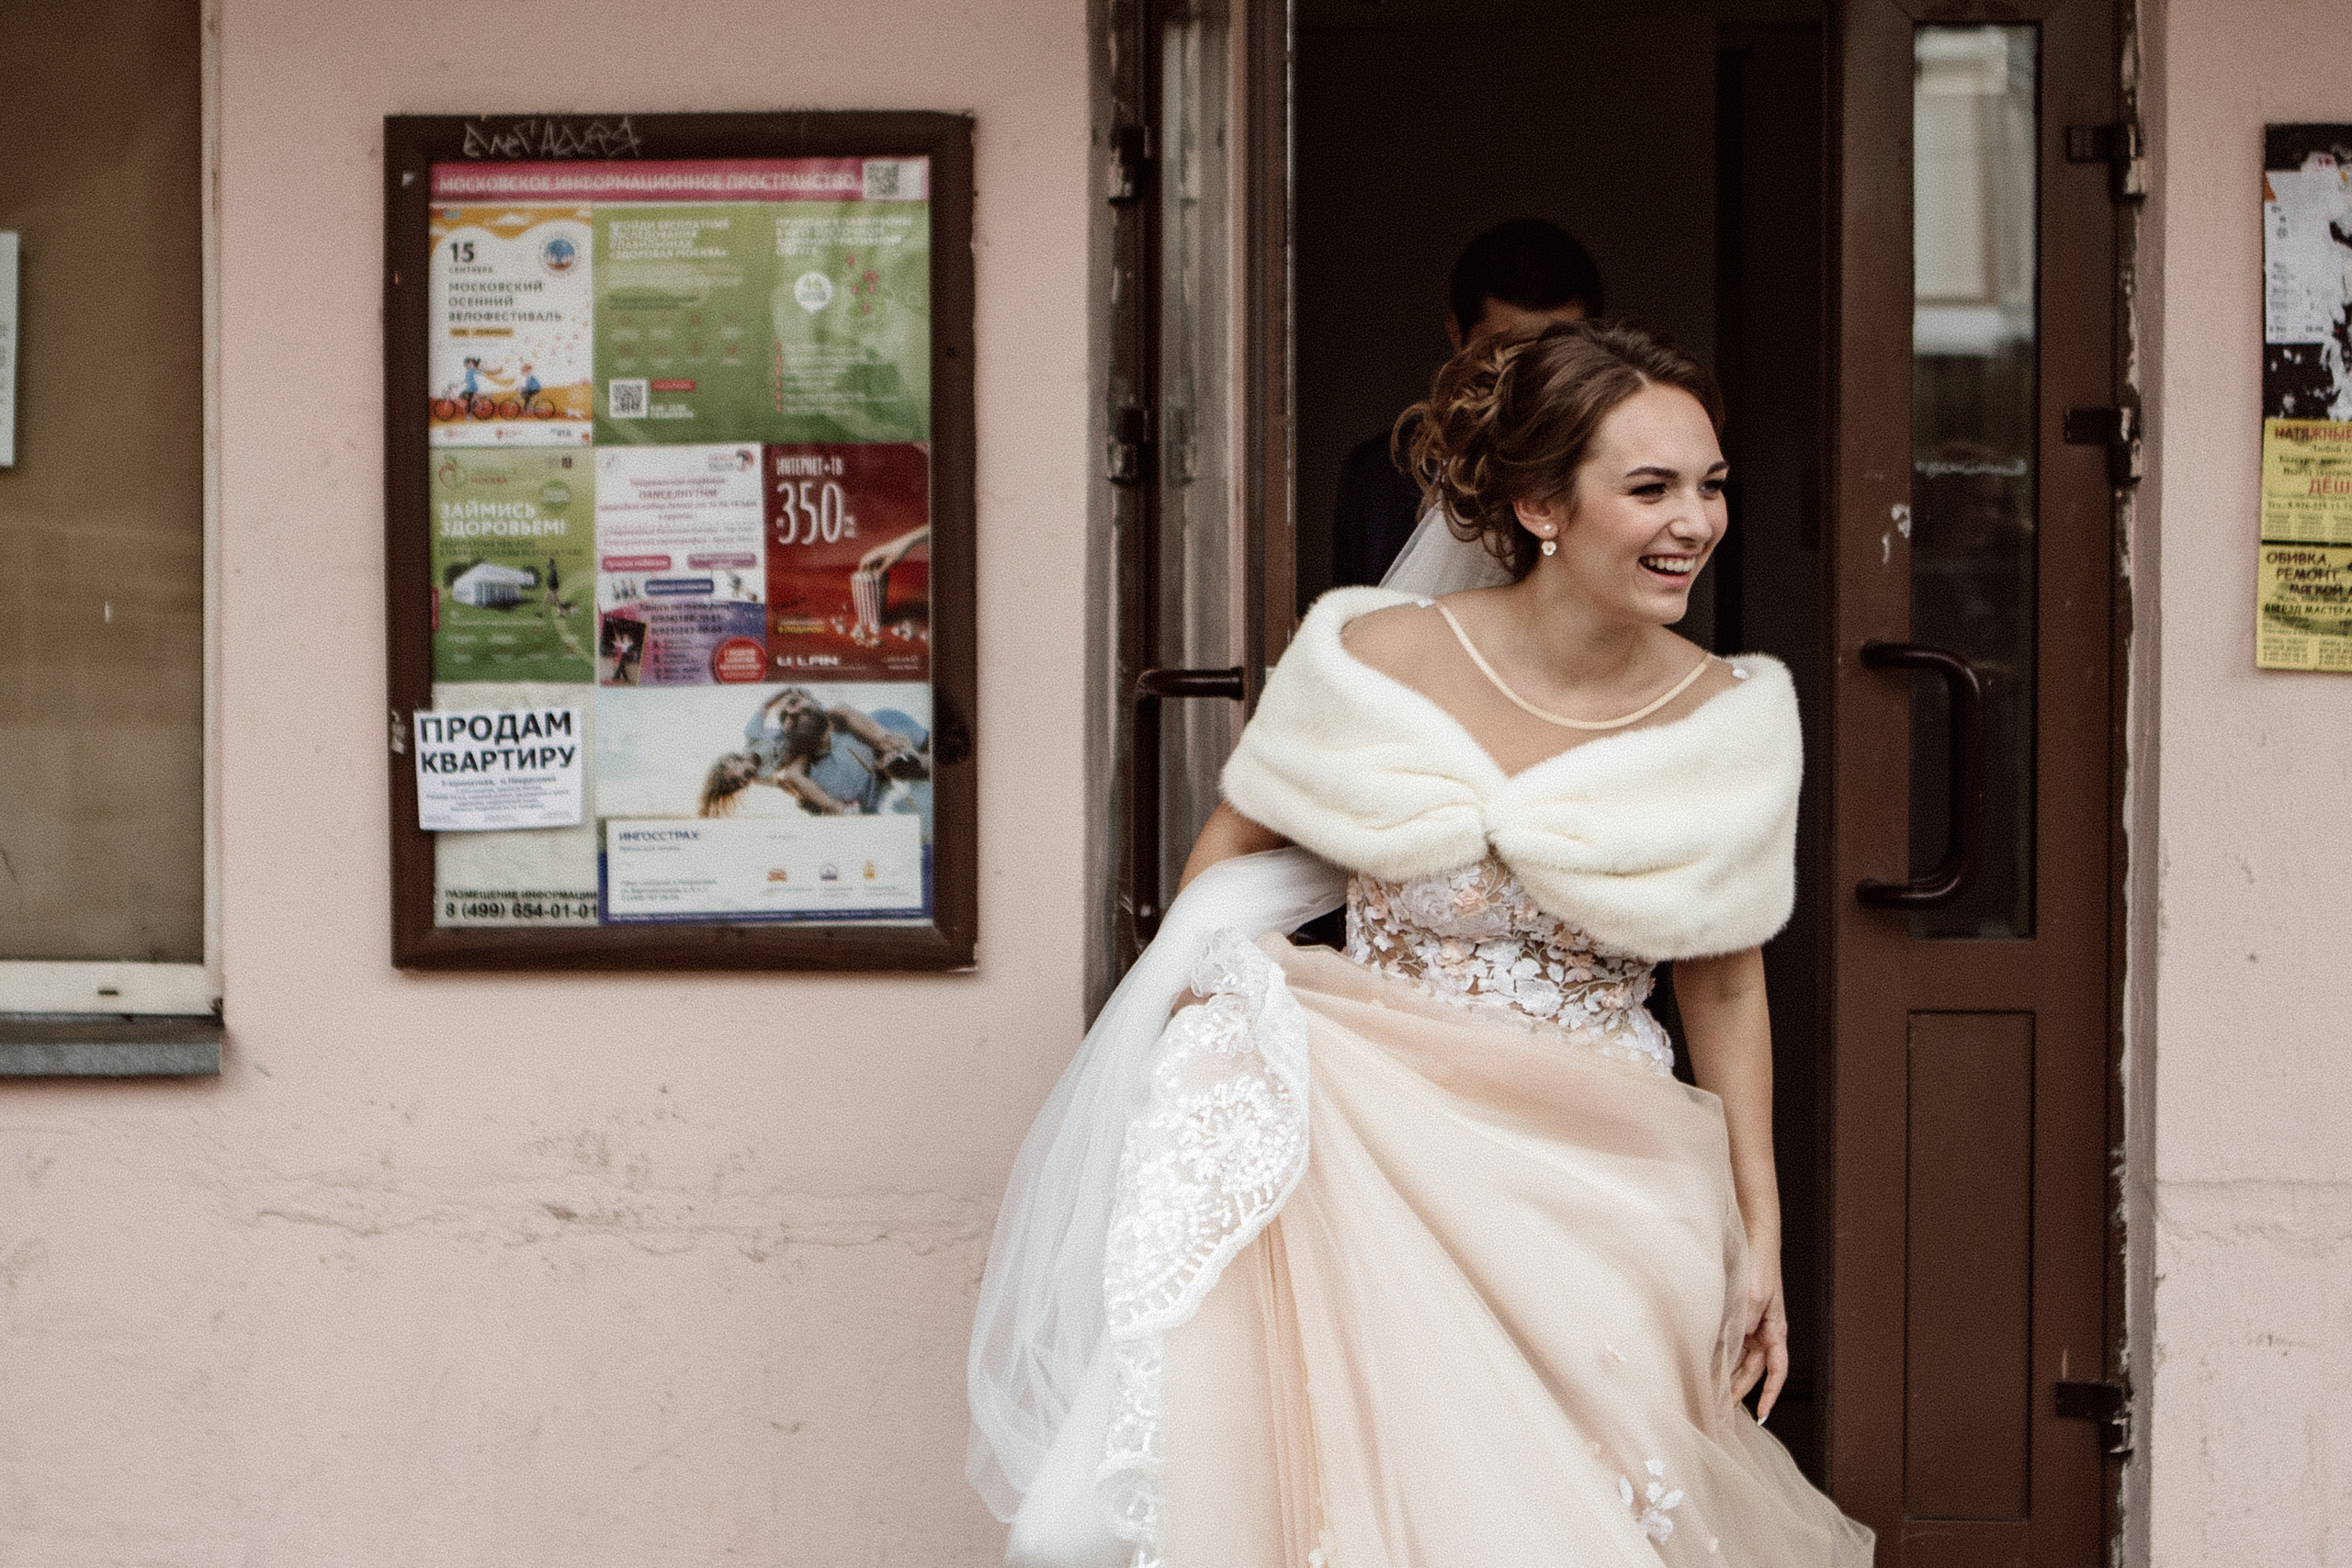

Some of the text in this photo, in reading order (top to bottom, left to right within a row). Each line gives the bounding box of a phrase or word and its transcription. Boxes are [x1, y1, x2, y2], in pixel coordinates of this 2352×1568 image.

[439, 173, 855, 193] МОСКОВСКОЕ ИНФОРМАЦИОННОЕ ПРОСТРАНСТВО
[449, 242, 476, 263] 15
[448, 280, 543, 293] МОСКОВСКИЙ
[448, 295, 514, 307] ОСЕННИЙ
[448, 310, 562, 322] ВЕЛОФЕСТИВАЛЬ
[439, 499, 537, 519] ЗАЙМИСЬ
[776, 481, 843, 545] 350
[439, 519, 567, 538] ЗДОРОВЬЕМ!
[2276, 567, 2338, 582] РЕМОНТ
[2290, 582, 2343, 597] МЯГКОЙ
[420, 710, 572, 746] ПРОДАМ
[420, 745, 577, 774] КВАРТИРУ
[618, 830, 700, 841] ИНГОССТРАХ
[446, 889, 518, 899] РАЗМЕЩЕНИЕ
[446, 901, 598, 919] 8 (499) 654-01-01
